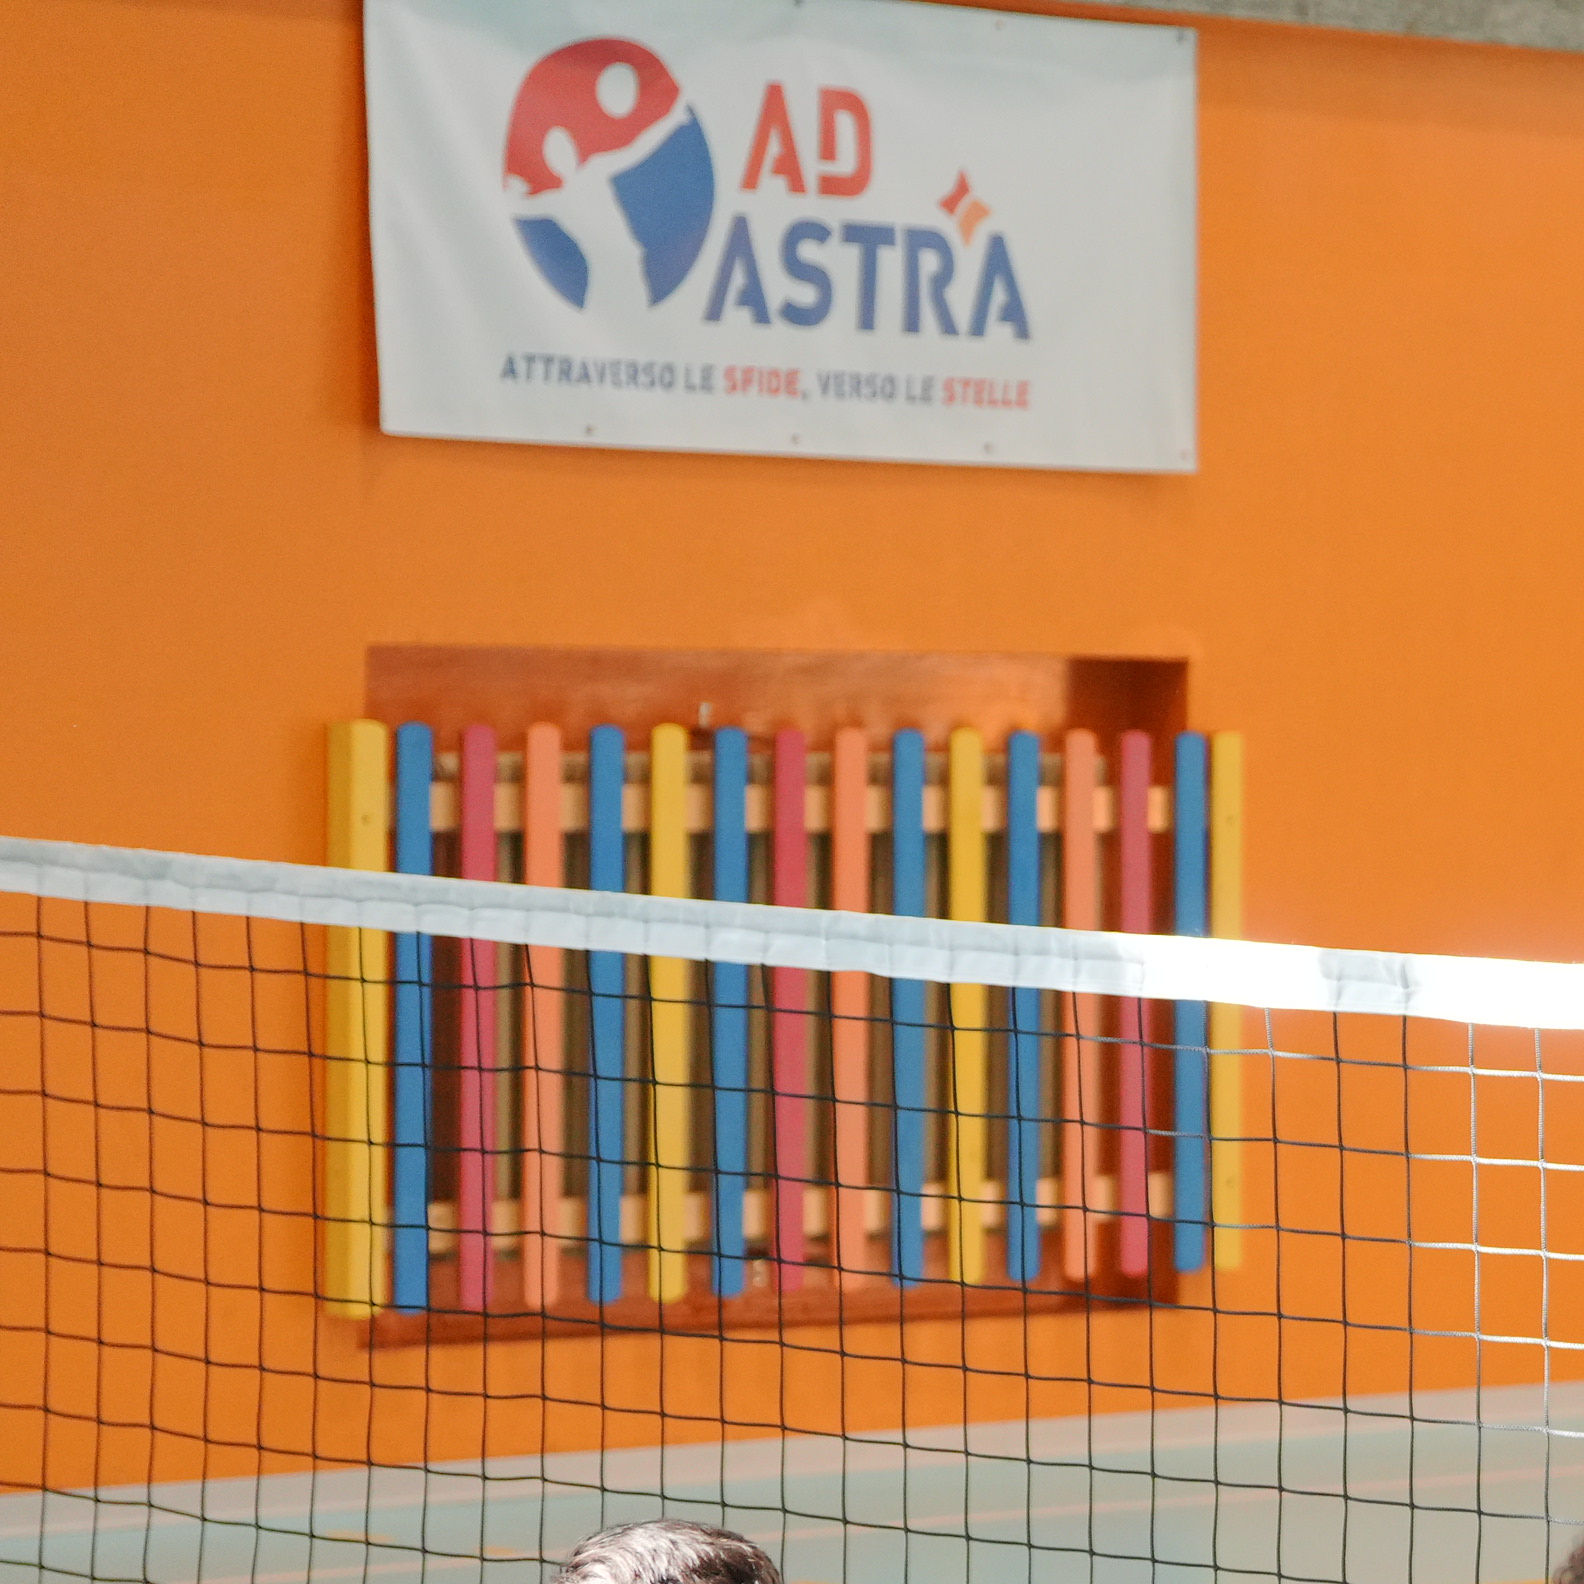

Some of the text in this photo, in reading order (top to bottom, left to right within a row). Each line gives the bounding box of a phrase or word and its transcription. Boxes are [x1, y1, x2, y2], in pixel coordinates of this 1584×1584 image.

[739, 80, 874, 199] AD
[701, 213, 1032, 342] ASTRA
[500, 352, 1031, 411] ATTRAVERSO LE SFIDE, VERSO LE STELLE
